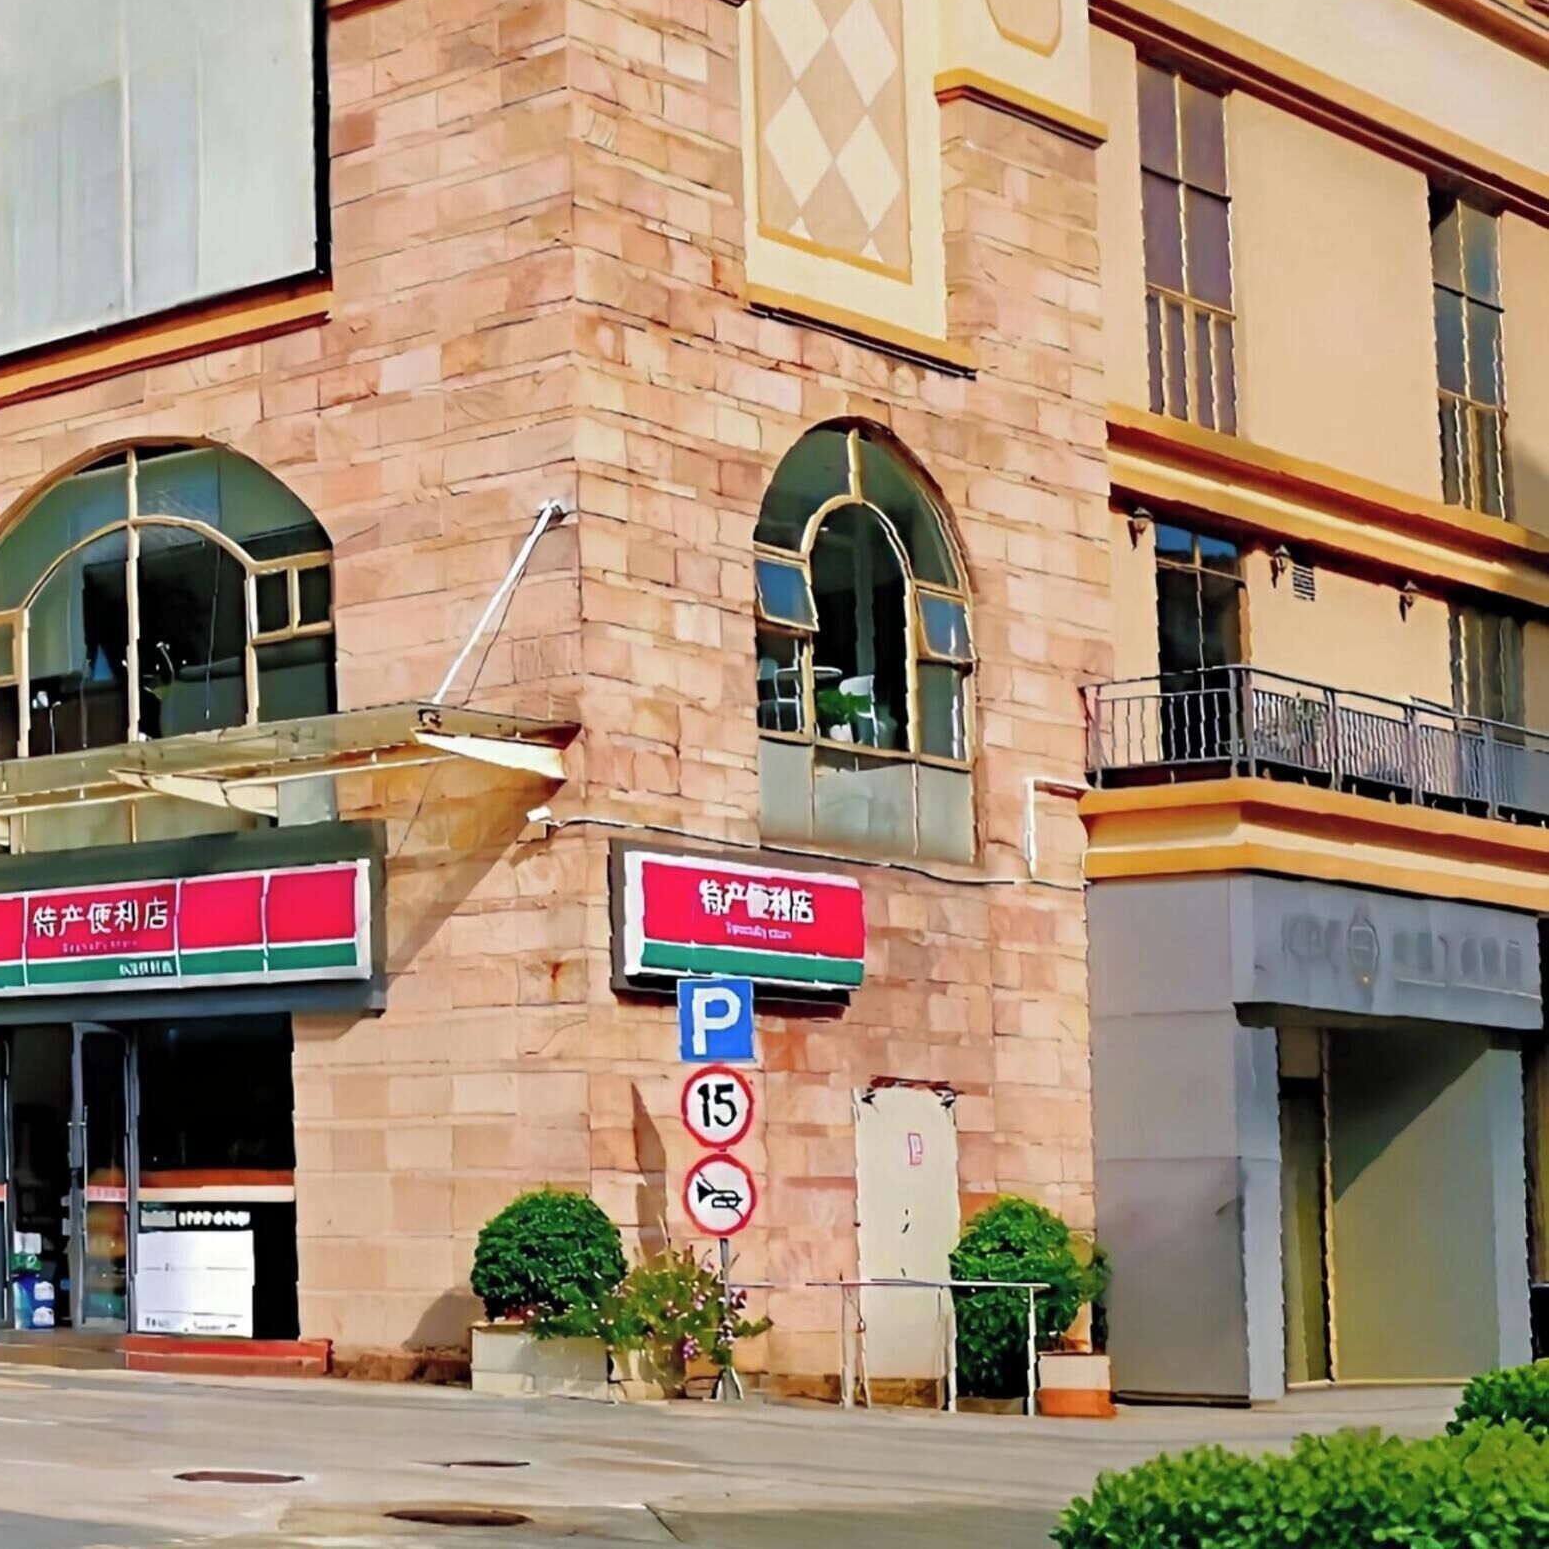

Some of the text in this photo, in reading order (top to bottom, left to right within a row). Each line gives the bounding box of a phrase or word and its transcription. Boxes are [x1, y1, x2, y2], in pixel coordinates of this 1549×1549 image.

[32, 895, 169, 938] 特产便利店
[692, 987, 741, 1055] P
[697, 1083, 738, 1128] 15
